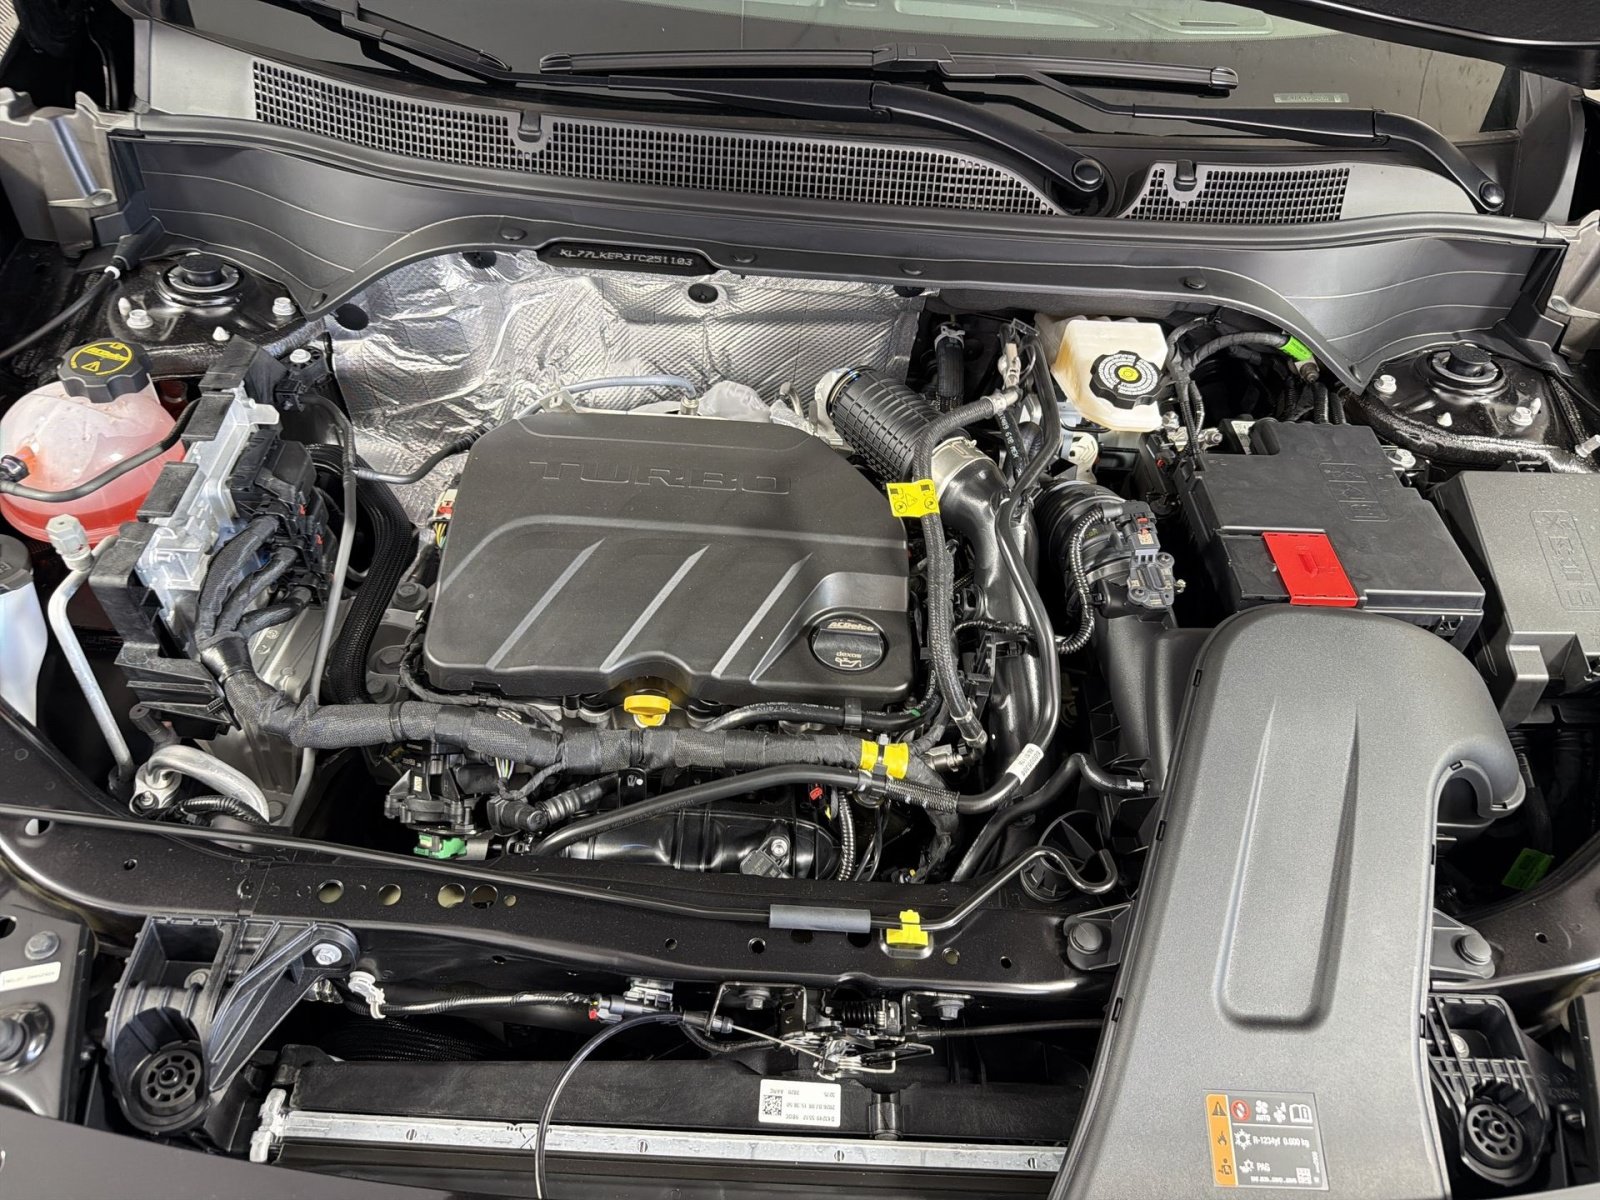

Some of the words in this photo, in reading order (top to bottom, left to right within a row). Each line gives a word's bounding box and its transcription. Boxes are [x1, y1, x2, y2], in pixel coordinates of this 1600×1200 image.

[559, 248, 693, 266] KL77LKEP3TC251103
[528, 460, 791, 496] TURBO
[827, 621, 874, 632] ACDelco
[836, 650, 862, 659] dexos
[1255, 1114, 1271, 1122] AUTO
[1301, 1137, 1310, 1148] kg
[1256, 1162, 1271, 1172] PAG
